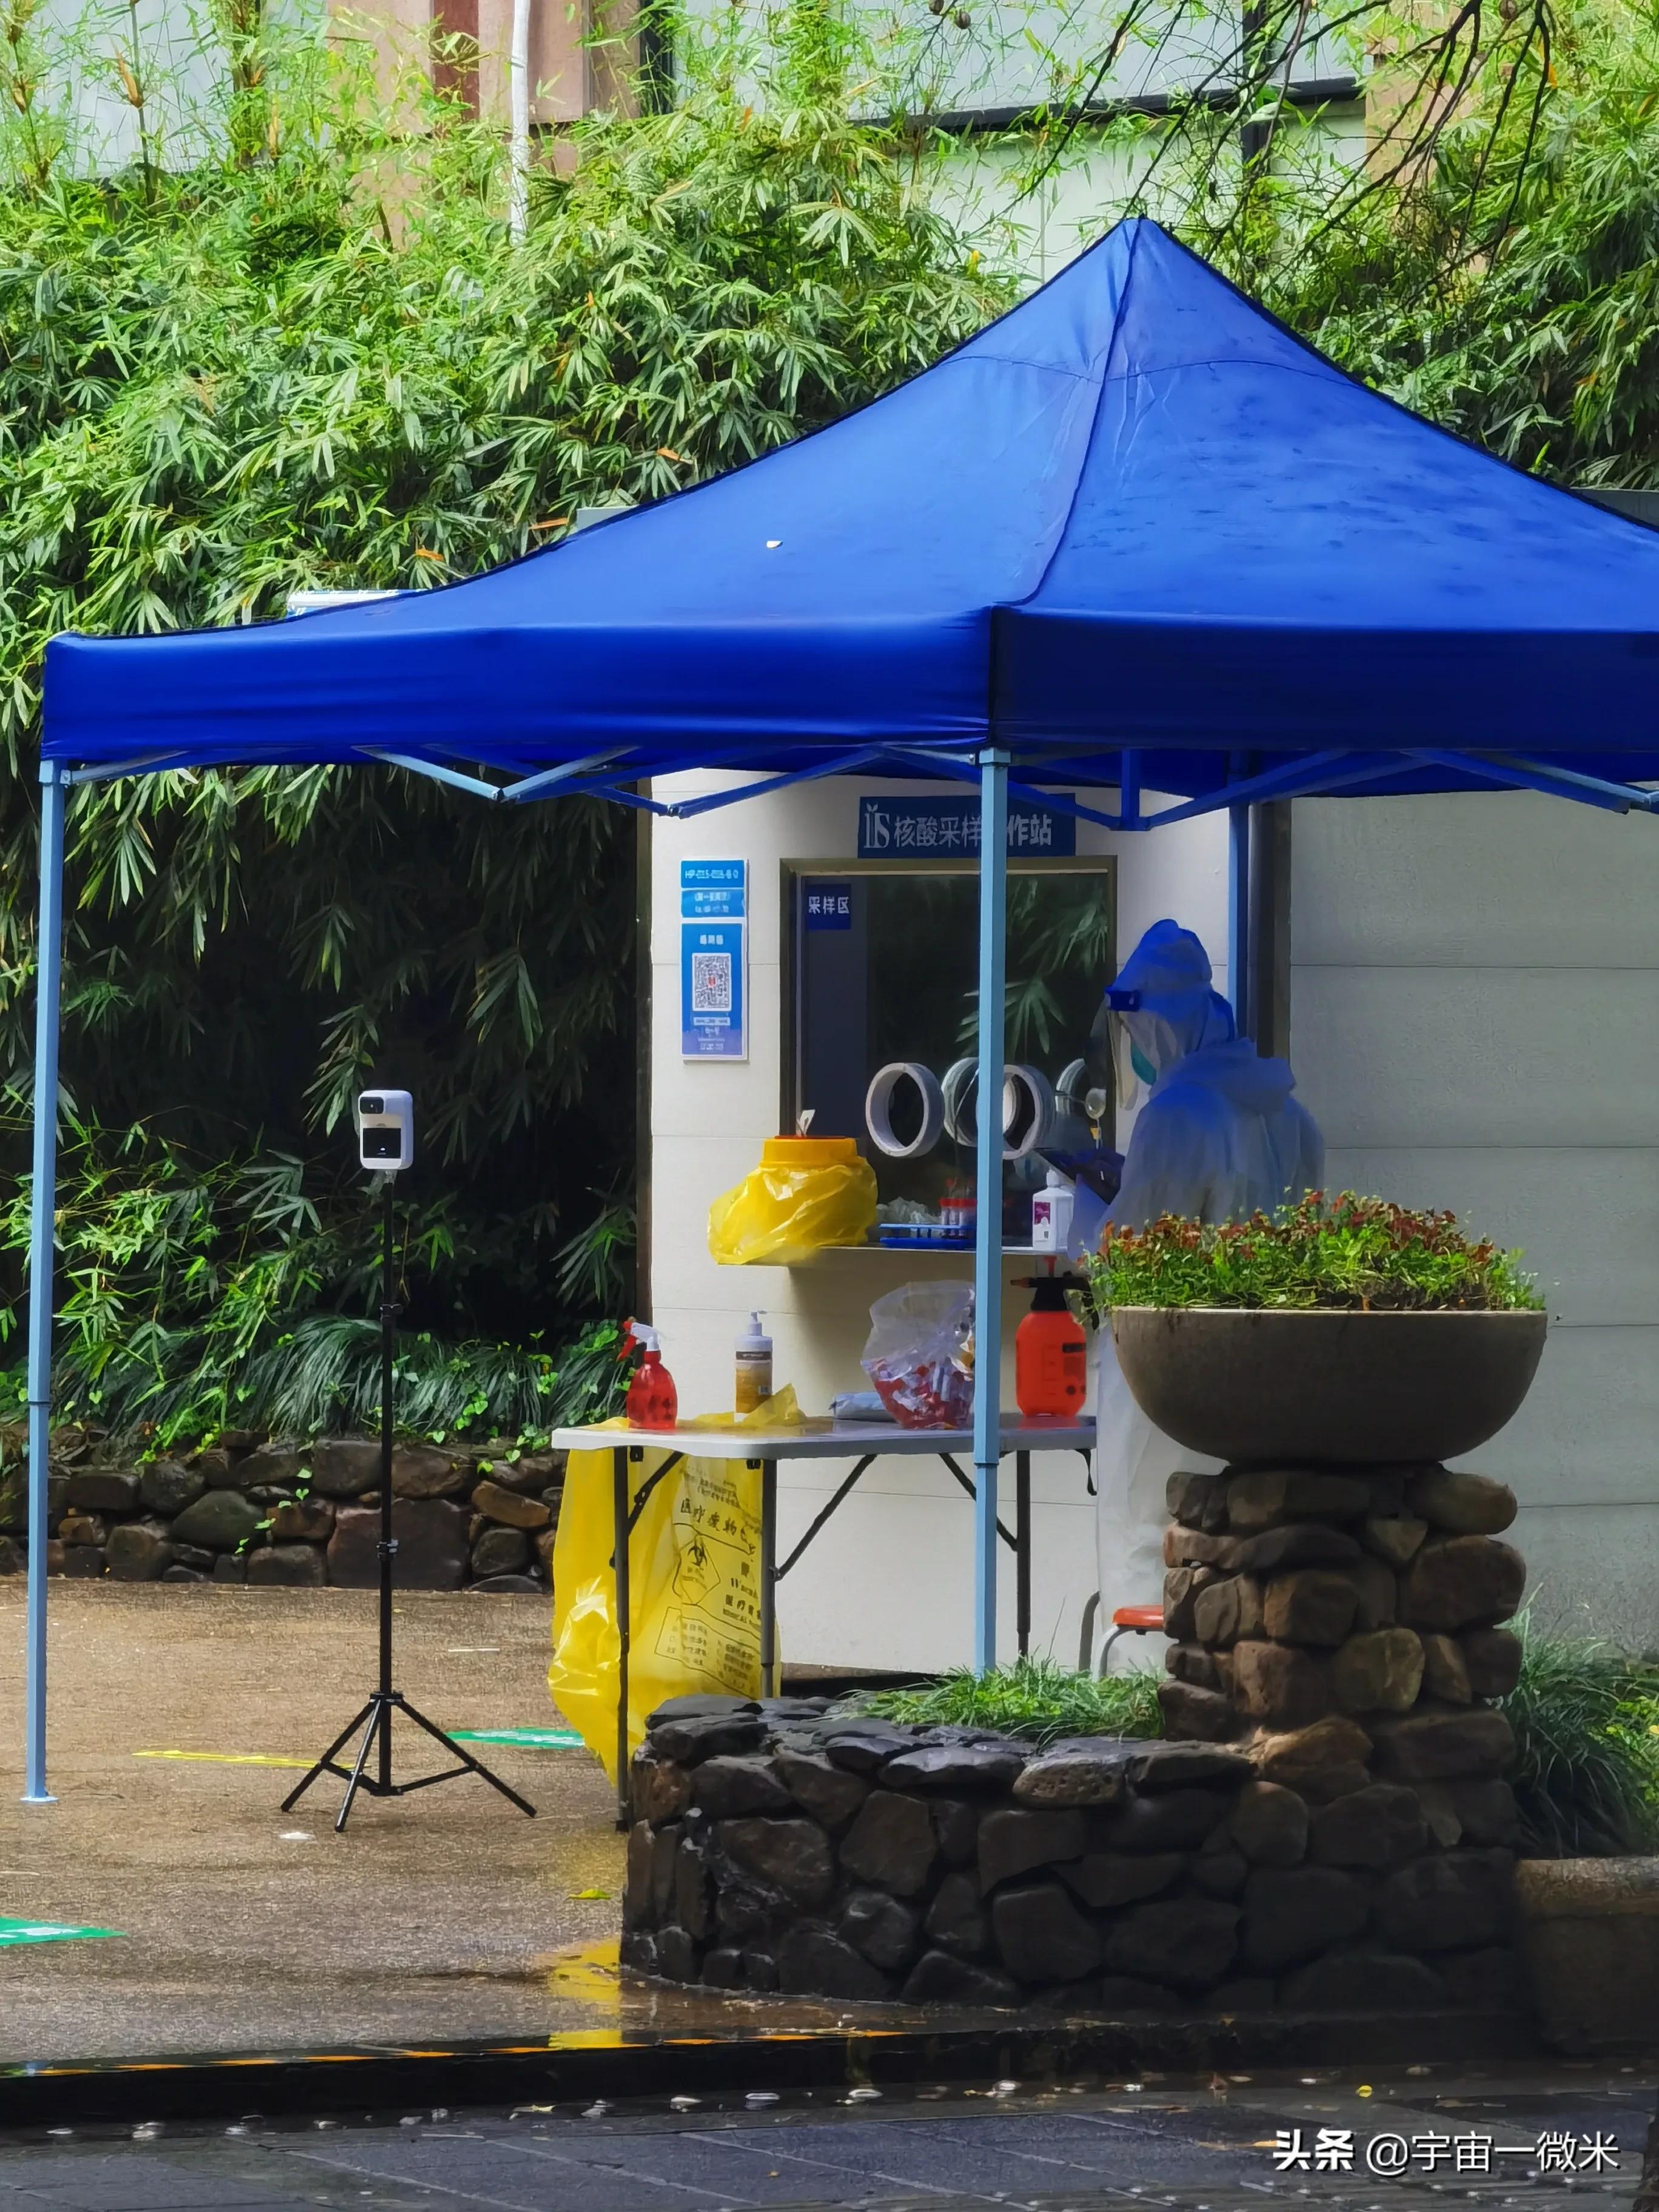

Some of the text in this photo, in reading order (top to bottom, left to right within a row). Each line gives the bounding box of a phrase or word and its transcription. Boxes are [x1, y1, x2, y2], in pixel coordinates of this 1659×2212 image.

[894, 814, 1052, 847] 核酸采样作站
[808, 896, 850, 915] 采样区
